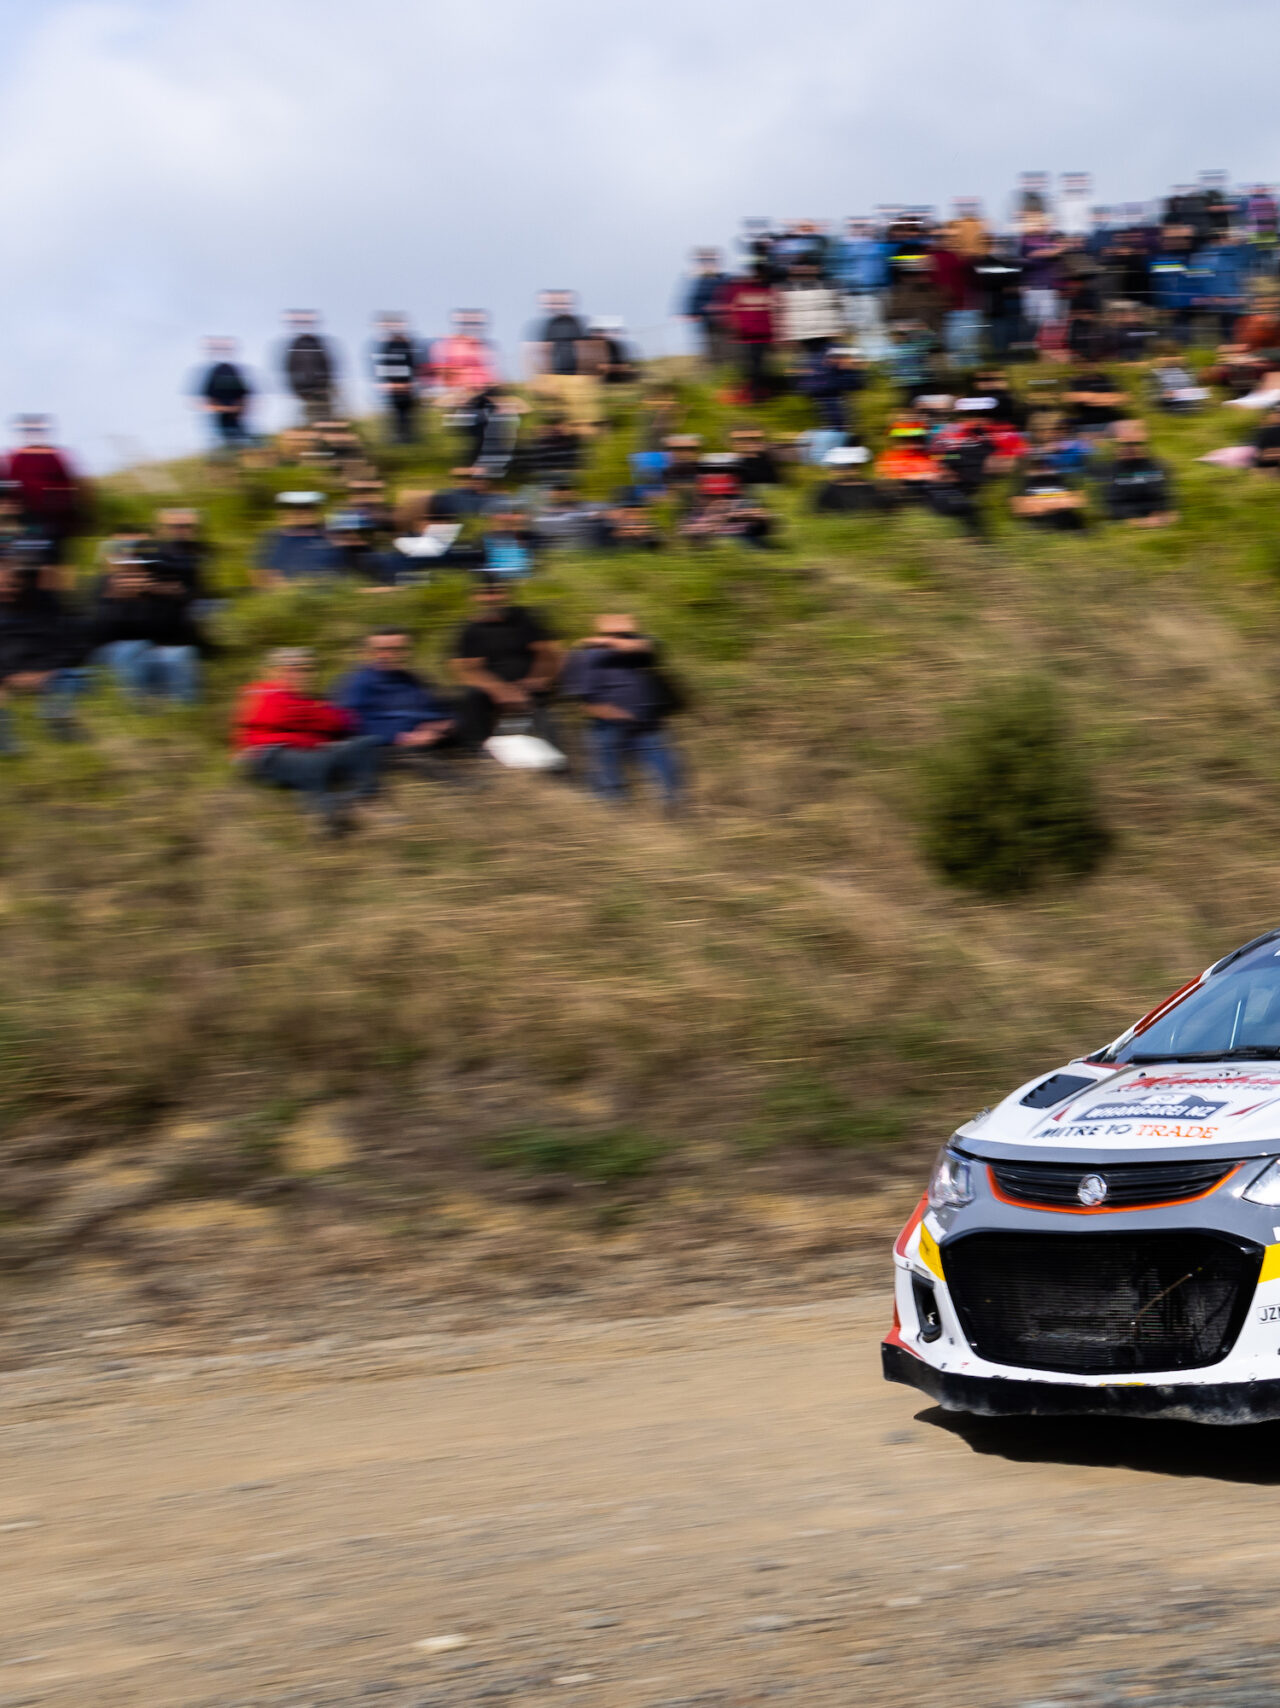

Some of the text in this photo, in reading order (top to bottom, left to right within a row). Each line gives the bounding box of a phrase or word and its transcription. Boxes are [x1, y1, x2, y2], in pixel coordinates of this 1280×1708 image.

[1032, 1123, 1219, 1139] MITRE 10 TRADE
